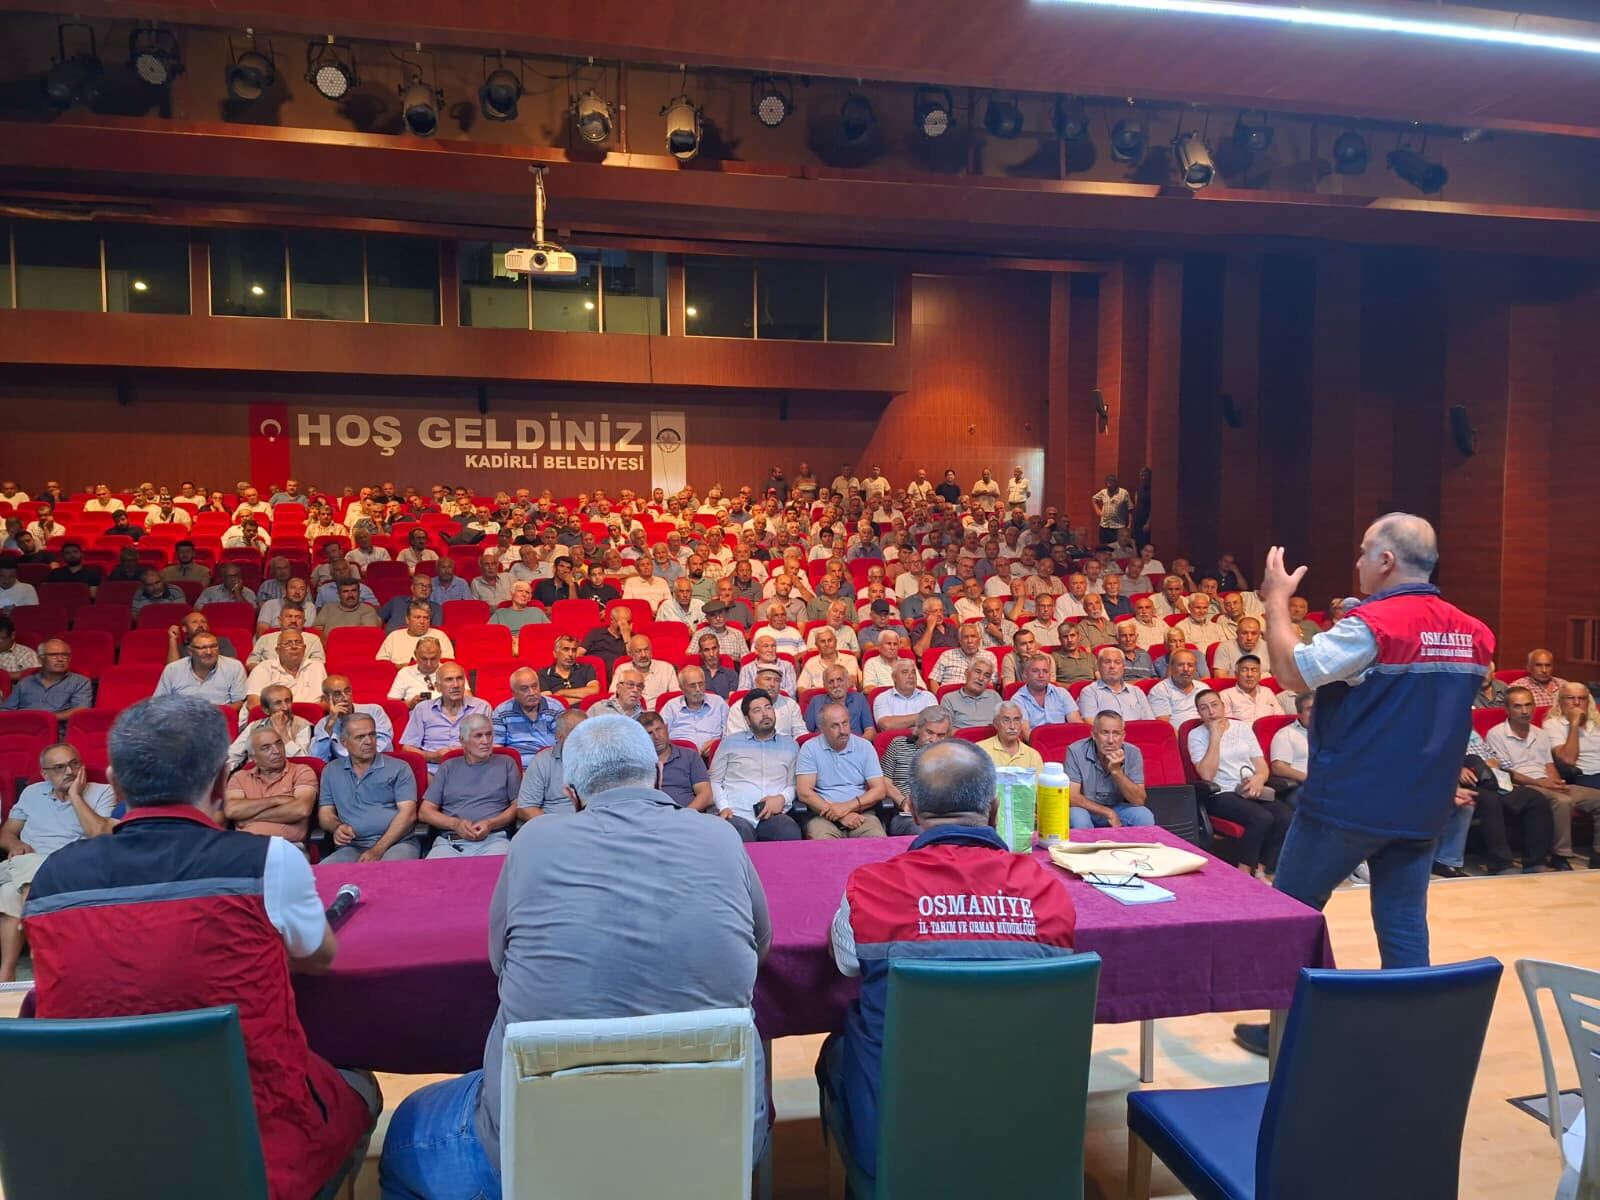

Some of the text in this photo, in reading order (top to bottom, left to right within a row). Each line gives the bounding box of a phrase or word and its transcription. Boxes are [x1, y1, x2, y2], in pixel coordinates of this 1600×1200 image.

[298, 413, 402, 456] HOŞ
[418, 412, 644, 452] GELDİNİZ
[465, 453, 644, 471] KADİRLİ BELEDİYESİ
[1420, 630, 1473, 647] OSMANİYE
[918, 889, 1034, 918] OSMANİYE
[930, 921, 957, 934] TARIM
[957, 921, 968, 934] VE
[969, 921, 995, 934] ORMAN
